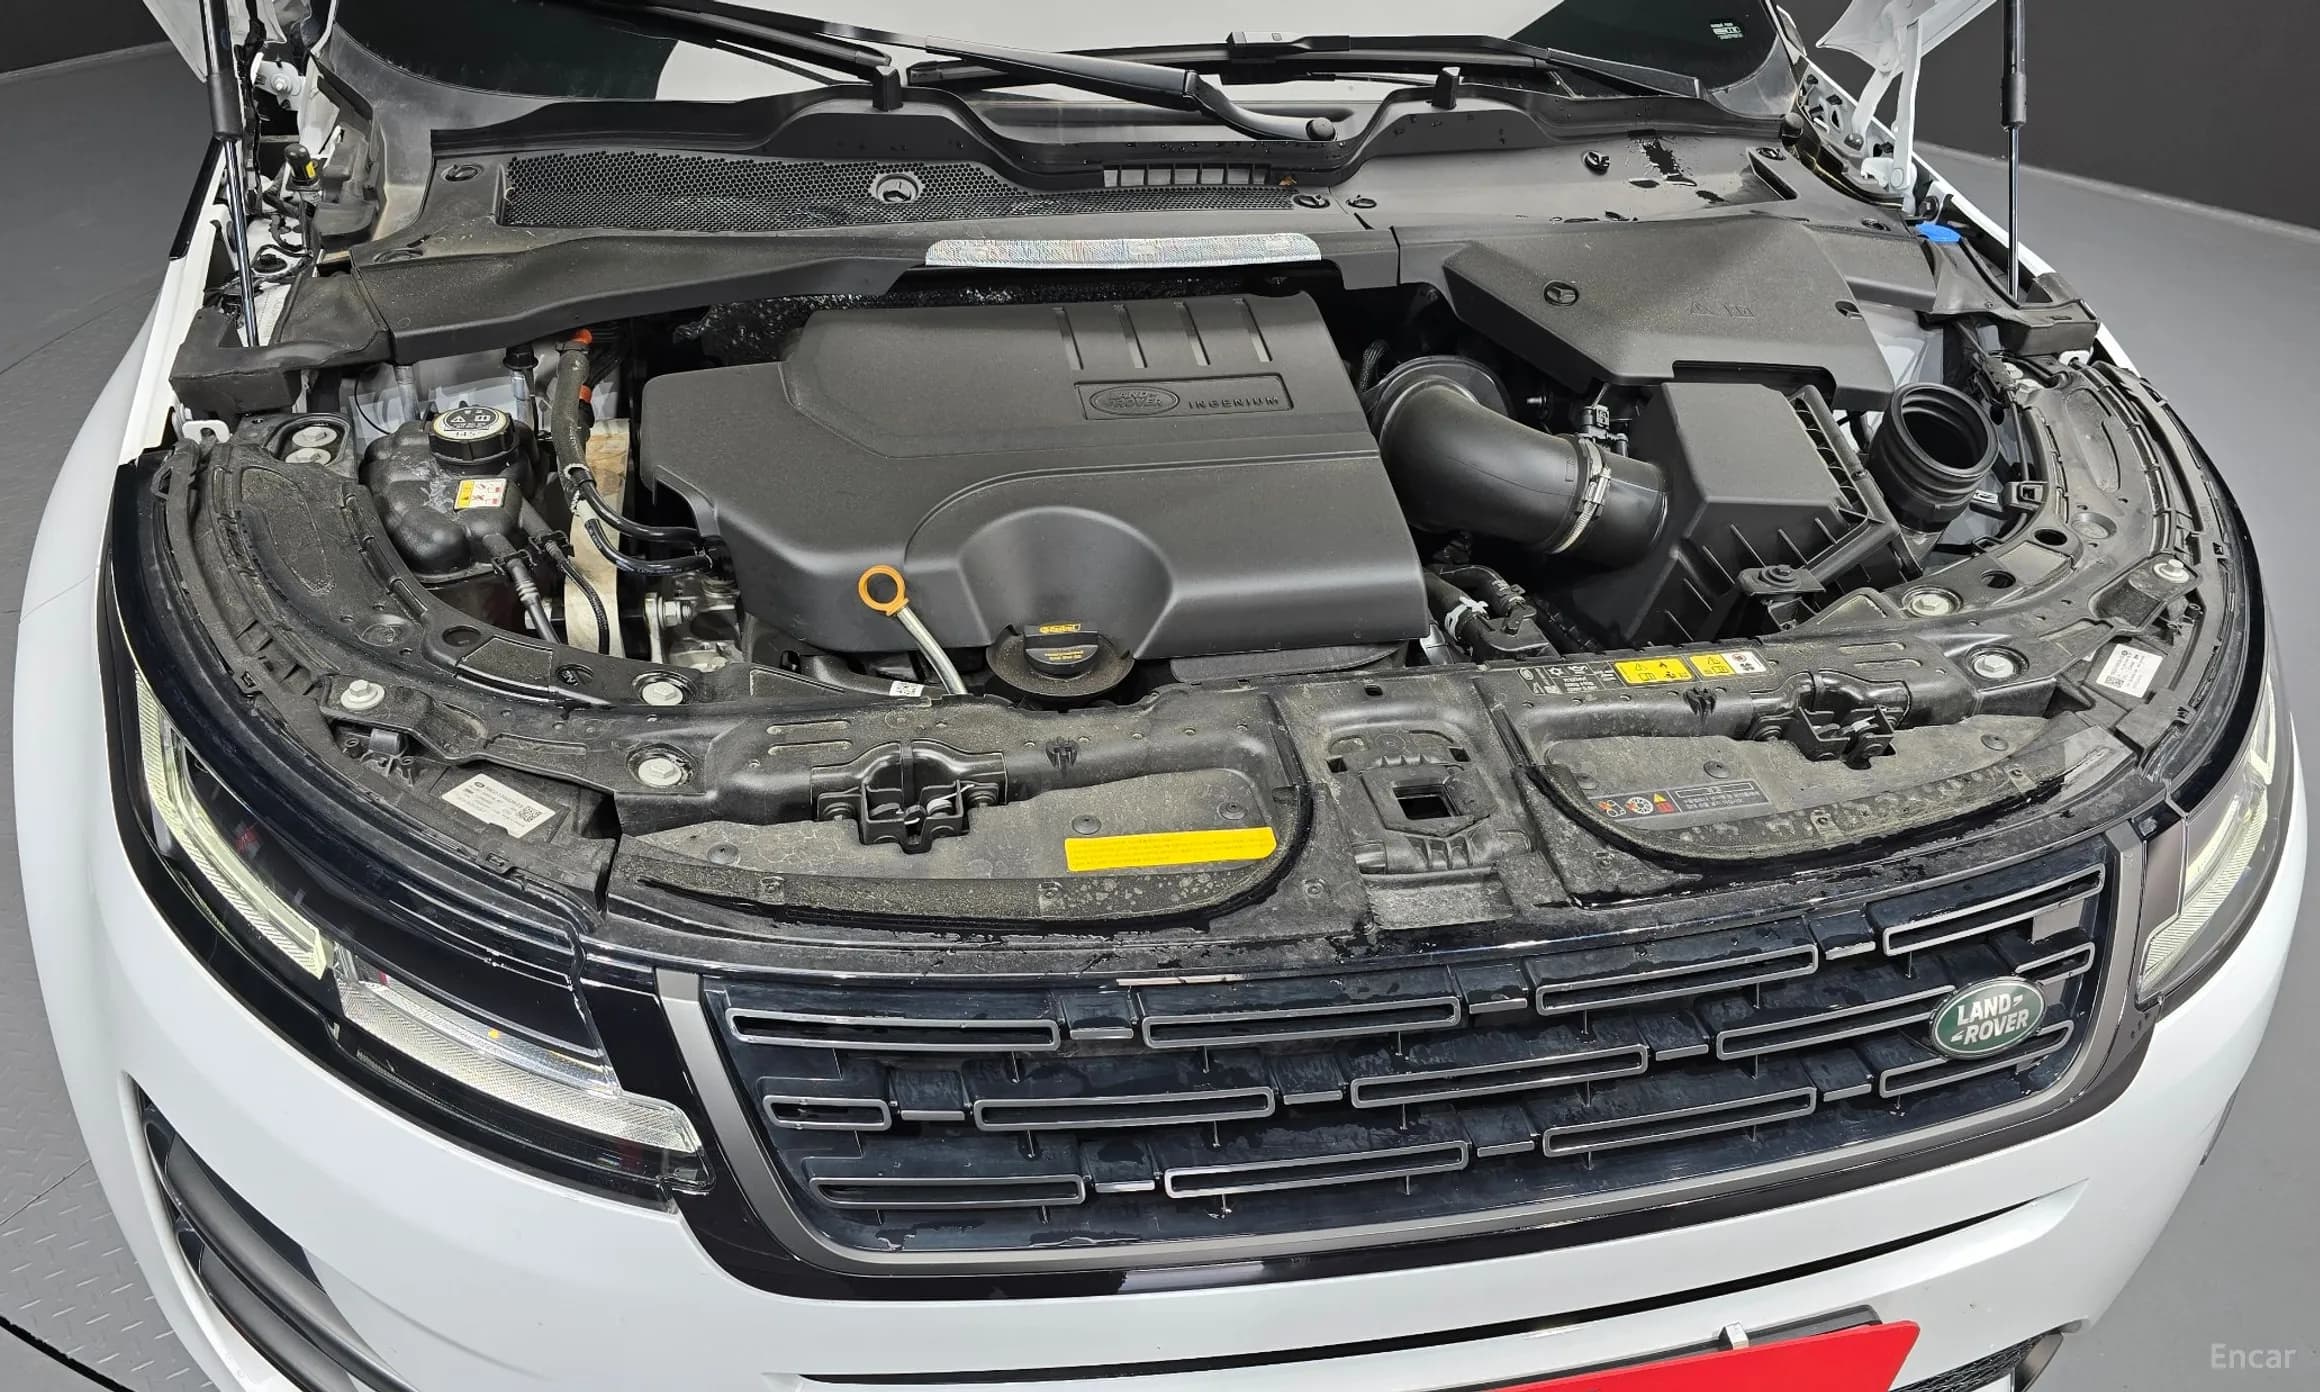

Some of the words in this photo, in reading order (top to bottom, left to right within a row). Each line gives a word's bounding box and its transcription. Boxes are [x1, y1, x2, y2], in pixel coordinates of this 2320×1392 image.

[1188, 396, 1280, 409] INGENIUM
[1957, 993, 2012, 1026] LAND
[1963, 1008, 2030, 1046] ROVER
